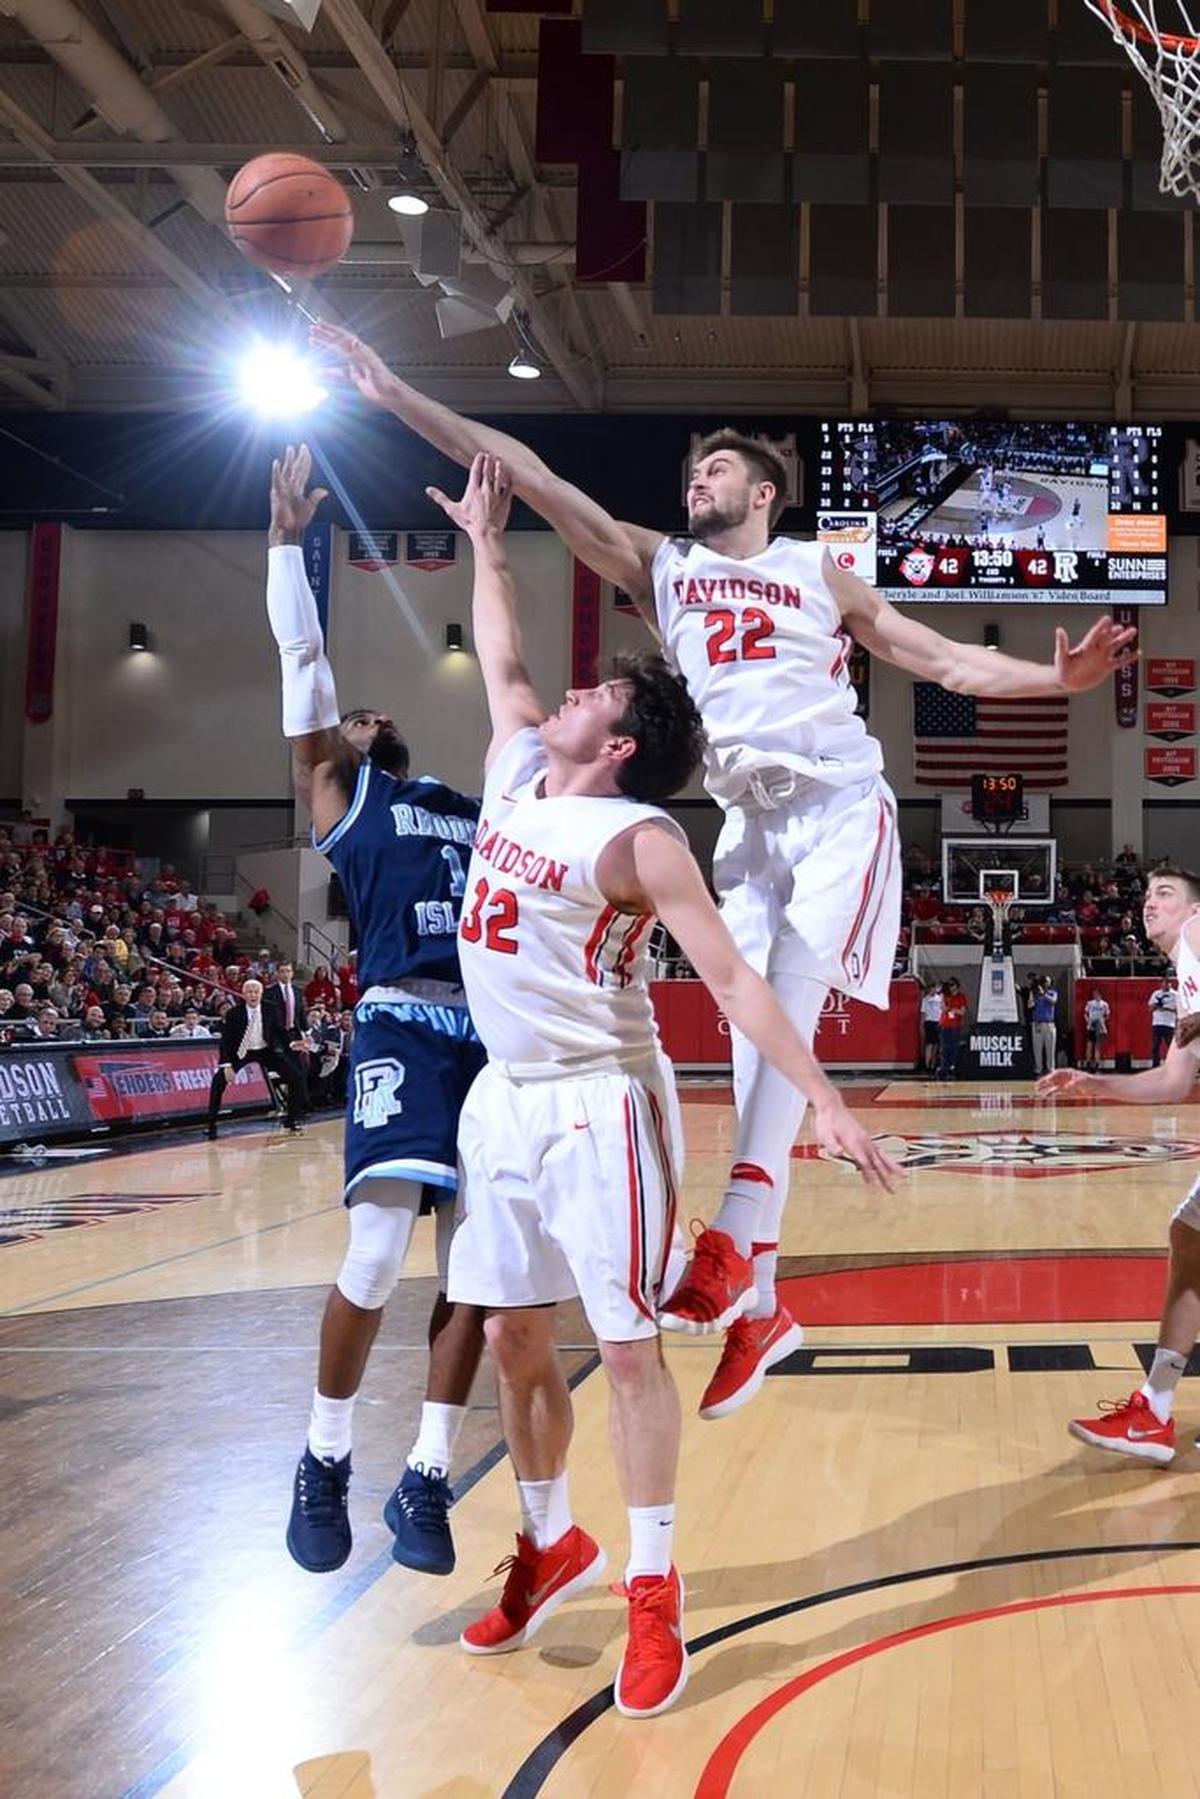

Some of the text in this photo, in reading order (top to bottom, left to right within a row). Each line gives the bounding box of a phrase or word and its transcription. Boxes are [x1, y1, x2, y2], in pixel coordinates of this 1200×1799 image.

[837, 422, 854, 433] PTS
[818, 516, 866, 530] CAROLINA
[938, 557, 959, 574] 42
[971, 550, 1013, 567] 13:50
[1027, 558, 1048, 575] 42
[1108, 571, 1167, 581] ENTERPRISES
[922, 590, 941, 600] and
[945, 590, 964, 600] Joel
[968, 590, 1029, 600] Williamson
[1048, 591, 1079, 600] Video
[1080, 591, 1111, 601] Board
[704, 607, 777, 666] 22
[461, 877, 519, 955] 32
[969, 1035, 1023, 1051] MUSCLE
[979, 1052, 1013, 1067] MILK
